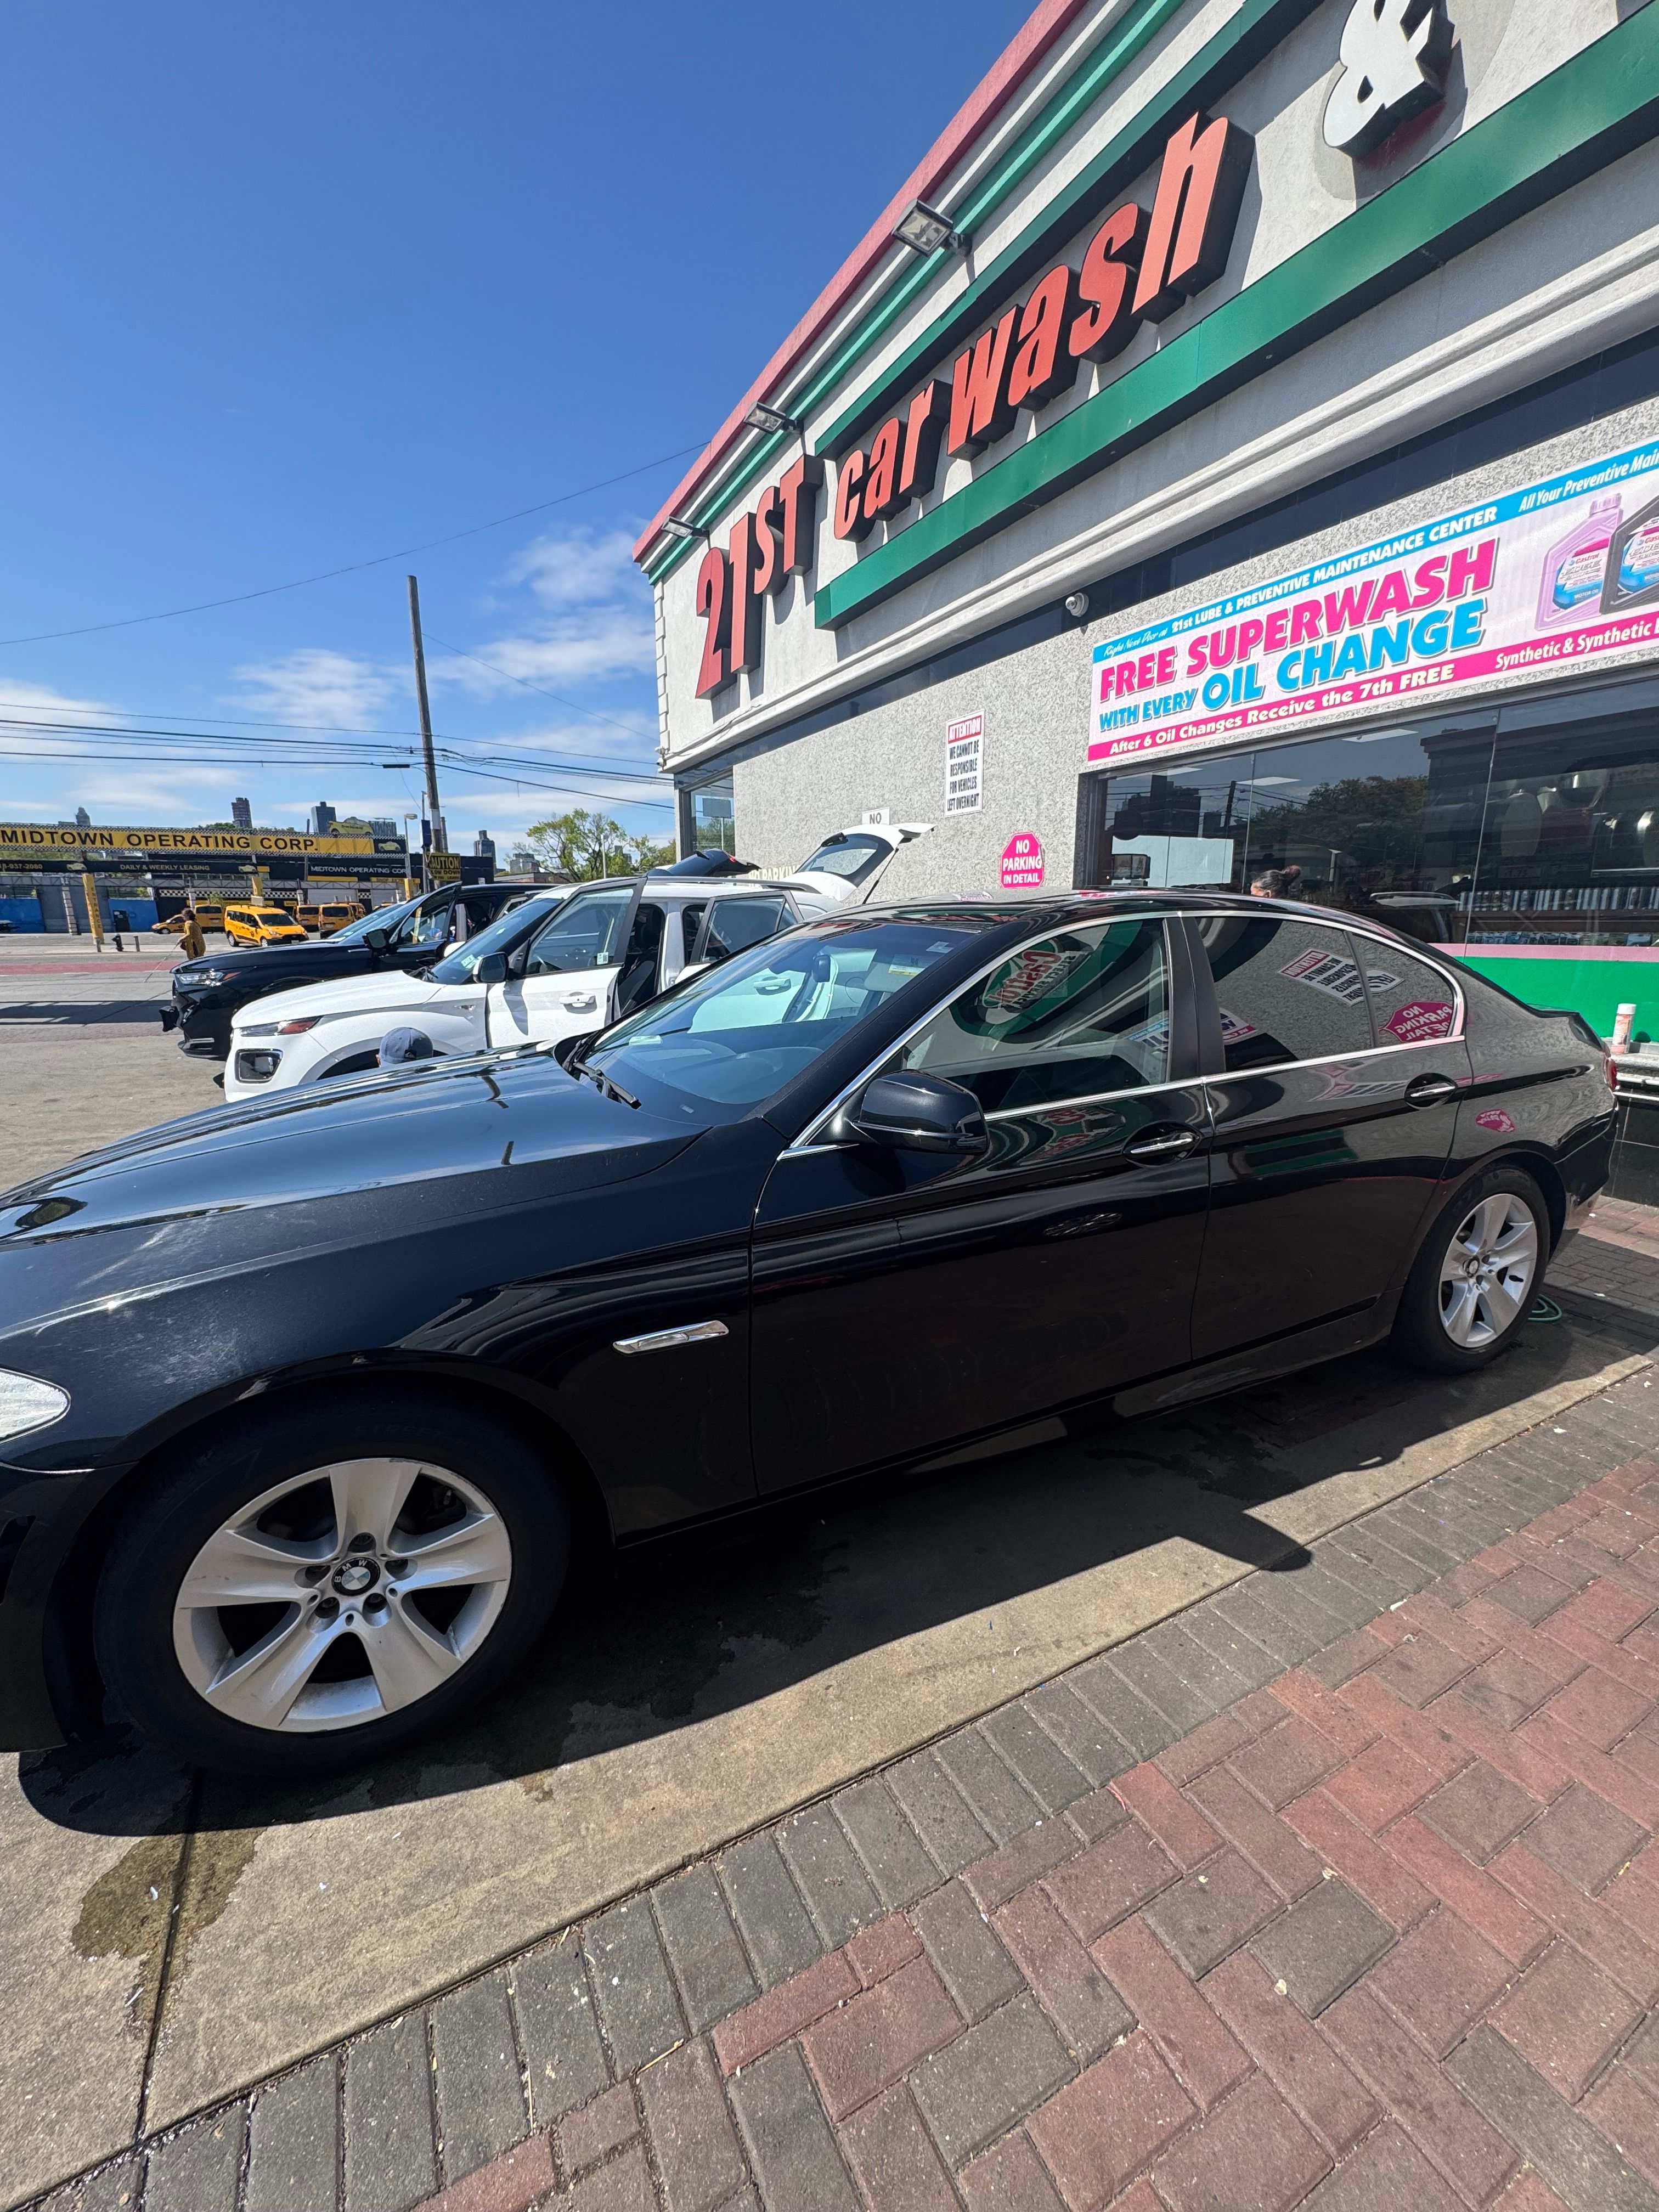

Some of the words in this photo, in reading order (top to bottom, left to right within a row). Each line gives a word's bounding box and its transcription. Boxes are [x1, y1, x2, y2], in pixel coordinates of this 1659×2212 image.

[1518, 493, 1536, 512] All
[1537, 489, 1560, 508] Your
[1563, 462, 1628, 498] Preventive
[695, 455, 806, 699] 21ST
[1171, 618, 1193, 634] 21st
[1195, 606, 1223, 625] LUBE
[1224, 601, 1233, 614] &
[1236, 573, 1310, 612] PREVENTIVE
[1313, 531, 1424, 584] MAINTENANCE
[1429, 505, 1498, 542] CENTER
[1100, 646, 1178, 703] FREE
[1186, 537, 1499, 678] SUPERWASH
[1495, 641, 1561, 672] Synthetic
[1562, 637, 1575, 652] &
[1576, 620, 1652, 652] Synthetic
[1099, 703, 1141, 733] WITH
[1142, 687, 1198, 720] EVERY
[1201, 663, 1265, 712] OIL
[1276, 598, 1487, 692] CHANGE
[1109, 740, 1141, 755] After
[1143, 736, 1152, 747] 6
[1155, 731, 1175, 744] Oil
[1179, 714, 1242, 737] Changes
[1246, 699, 1316, 725] Receive
[1322, 689, 1353, 707] the
[1359, 680, 1393, 699] 7th
[1398, 664, 1455, 689] FREE
[949, 717, 981, 741] ATTENTION
[949, 746, 956, 760] WE
[956, 741, 973, 758] CANNOT
[974, 740, 979, 753] BE
[950, 758, 978, 777] RESPONSIBLE
[958, 776, 977, 792] VEHICLES
[947, 798, 956, 811] LEFT
[956, 793, 979, 810] OVERNIGHT
[869, 812, 882, 824] NO
[1, 830, 114, 846] MIDTOWN
[126, 833, 250, 849] OPERATING
[259, 837, 318, 851] CORP.
[1015, 839, 1030, 854] NO
[429, 856, 460, 869] AUTION
[1002, 855, 1042, 872] PARKING
[762, 864, 800, 882] PARKIN
[1003, 874, 1012, 884] IN
[1013, 872, 1040, 885] DETAIL
[334, 1559, 368, 1583] BMW
